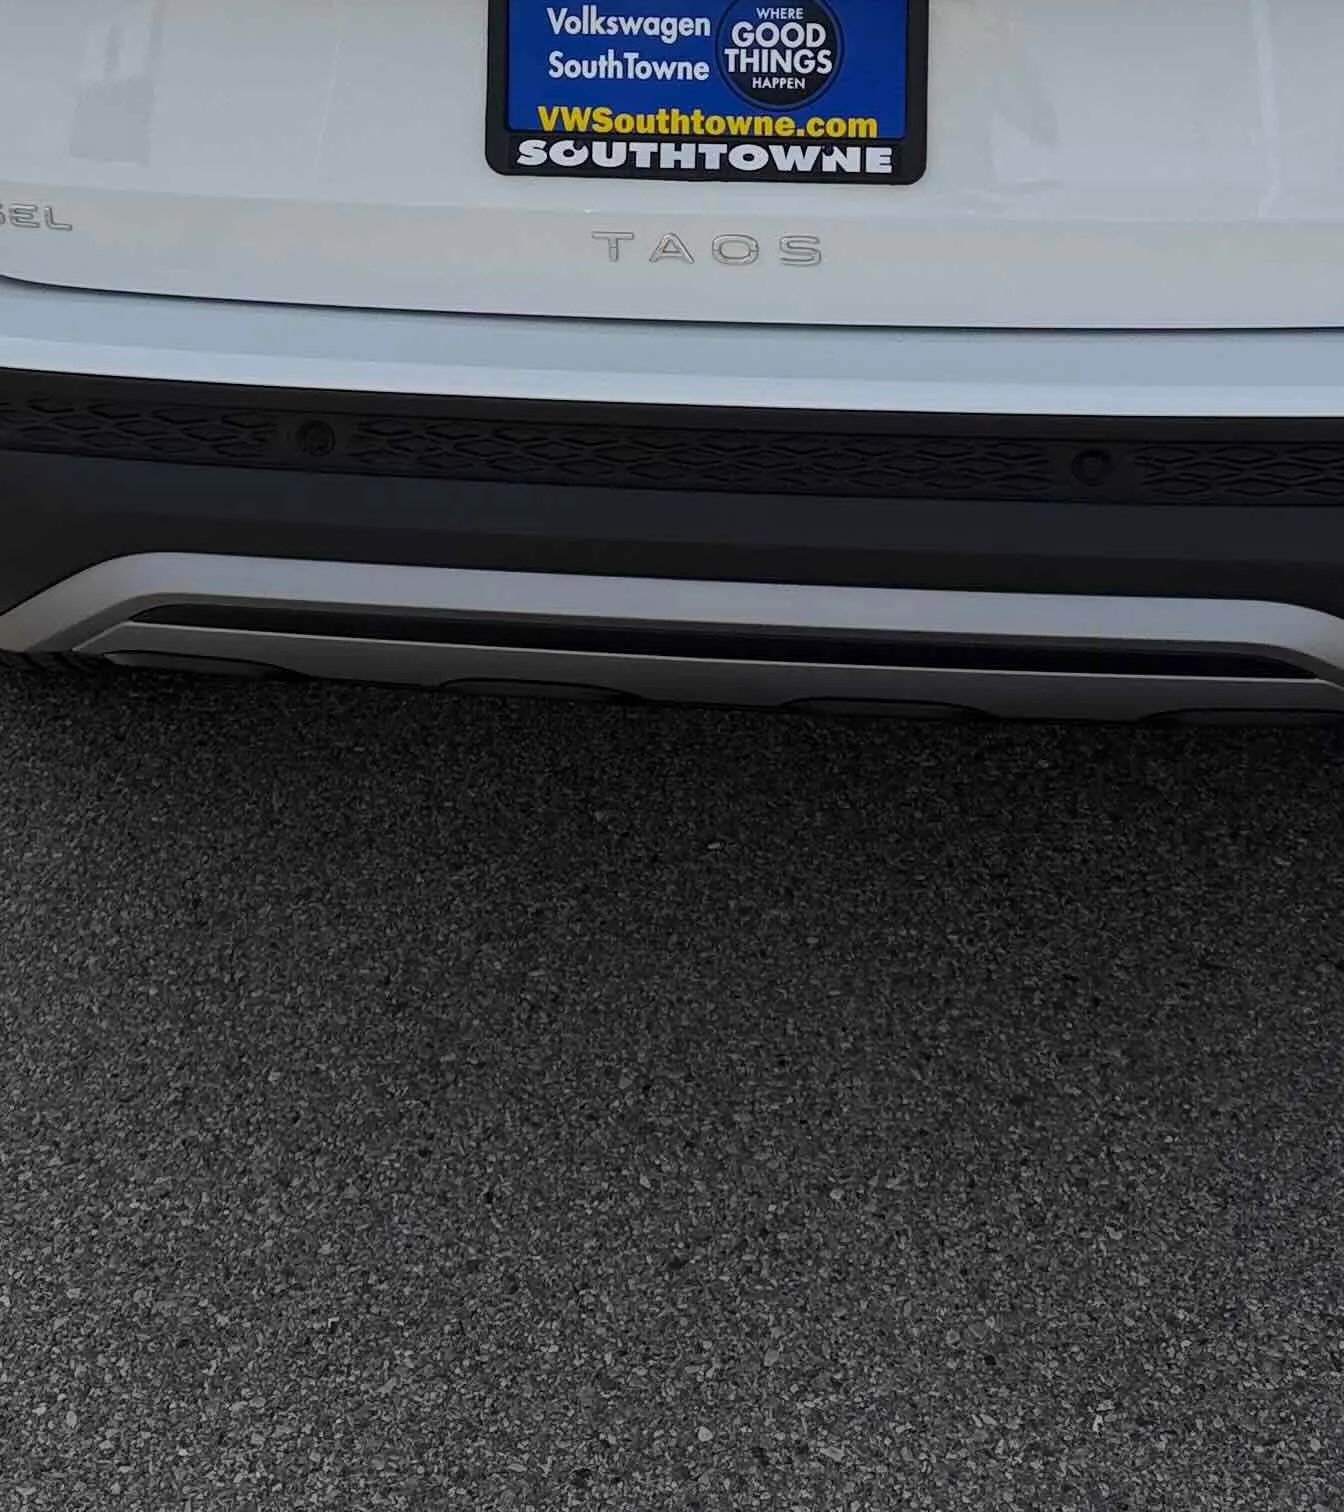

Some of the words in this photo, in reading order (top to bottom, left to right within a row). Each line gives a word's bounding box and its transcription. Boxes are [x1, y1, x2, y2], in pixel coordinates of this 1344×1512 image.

[547, 4, 712, 44] Volkswagen
[756, 8, 804, 20] WHERE
[731, 22, 826, 49] GOOD
[548, 50, 710, 81] SouthTowne
[724, 48, 832, 75] THINGS
[752, 77, 805, 90] HAPPEN
[537, 104, 878, 138] VWSouthtowne.com
[516, 139, 894, 174] SOUTHTOWNE
[591, 231, 822, 266] TAOS
